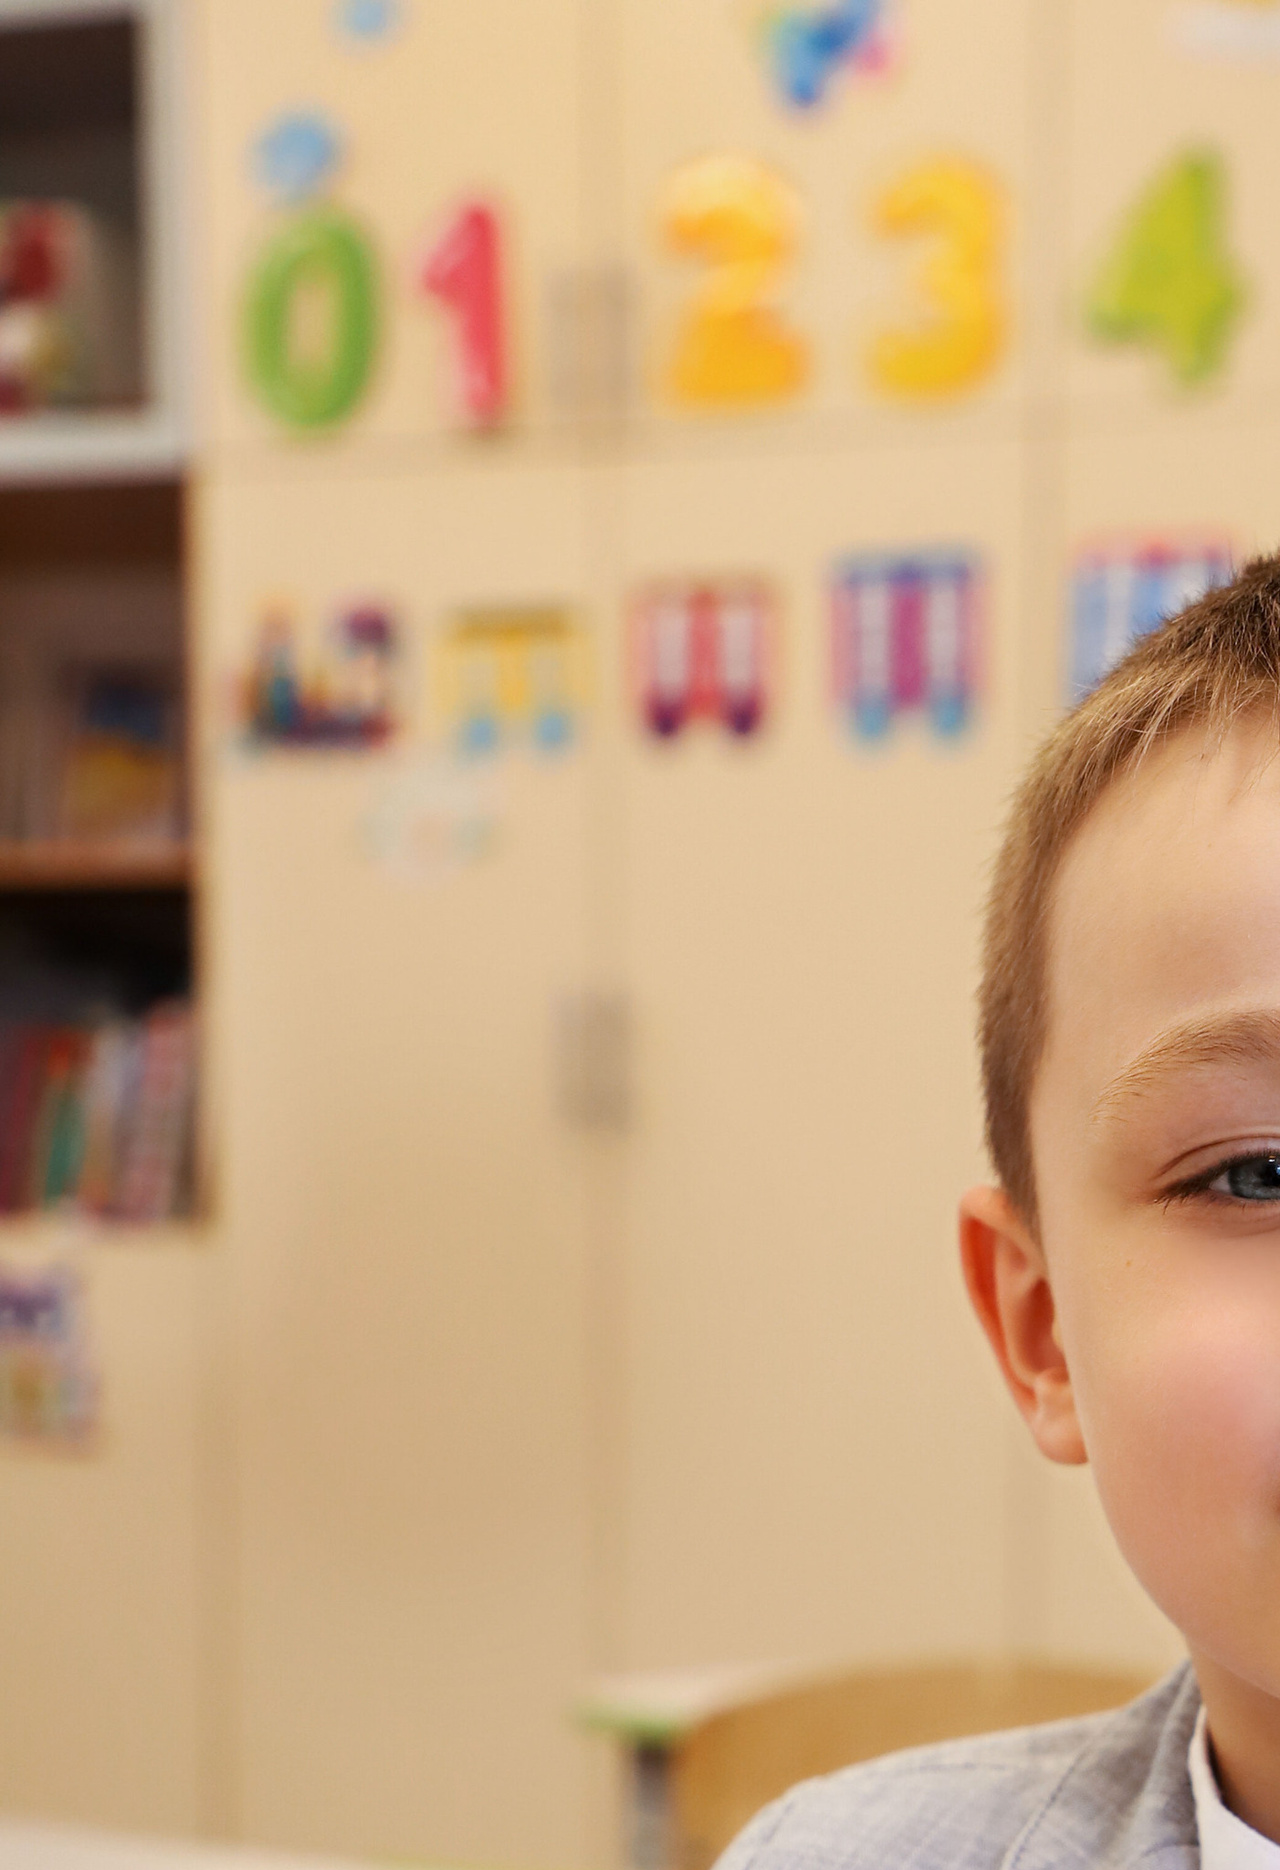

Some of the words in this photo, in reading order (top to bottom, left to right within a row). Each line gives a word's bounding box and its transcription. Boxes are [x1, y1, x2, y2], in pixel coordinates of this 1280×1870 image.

[418, 197, 508, 430] 1
[662, 155, 808, 412] 2
[868, 150, 1004, 406] 3
[1086, 142, 1246, 382] 4
